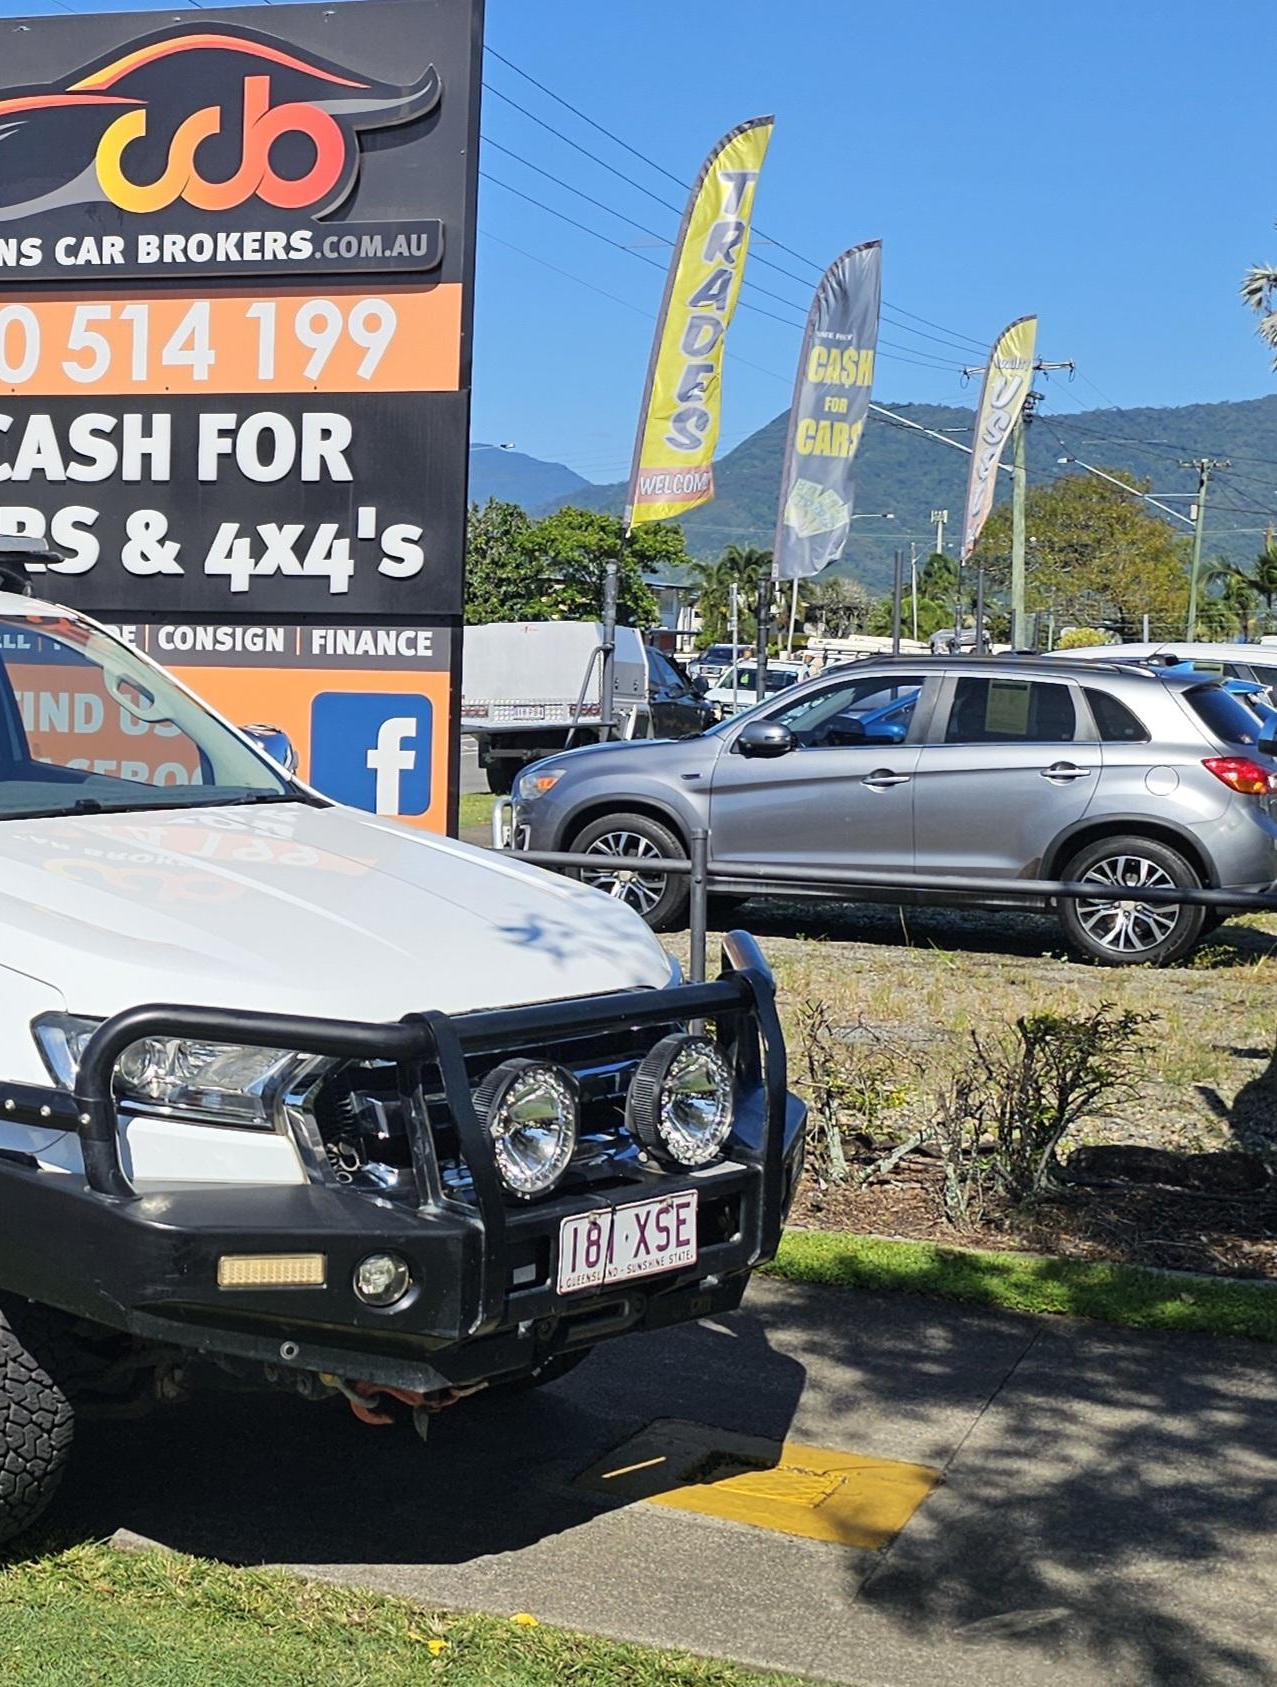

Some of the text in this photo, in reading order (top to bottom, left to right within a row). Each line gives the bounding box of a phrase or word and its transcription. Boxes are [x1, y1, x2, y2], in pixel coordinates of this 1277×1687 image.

[54, 235, 125, 266] CAR
[61, 299, 217, 383] 514
[245, 297, 398, 381] 199
[664, 169, 761, 453] TRADES
[824, 396, 849, 414] FOR
[197, 411, 354, 483] FOR
[121, 509, 185, 575] &
[157, 625, 285, 654] CONSIGN
[311, 628, 434, 657] FINANCE
[571, 1202, 691, 1273] 181 XSE
